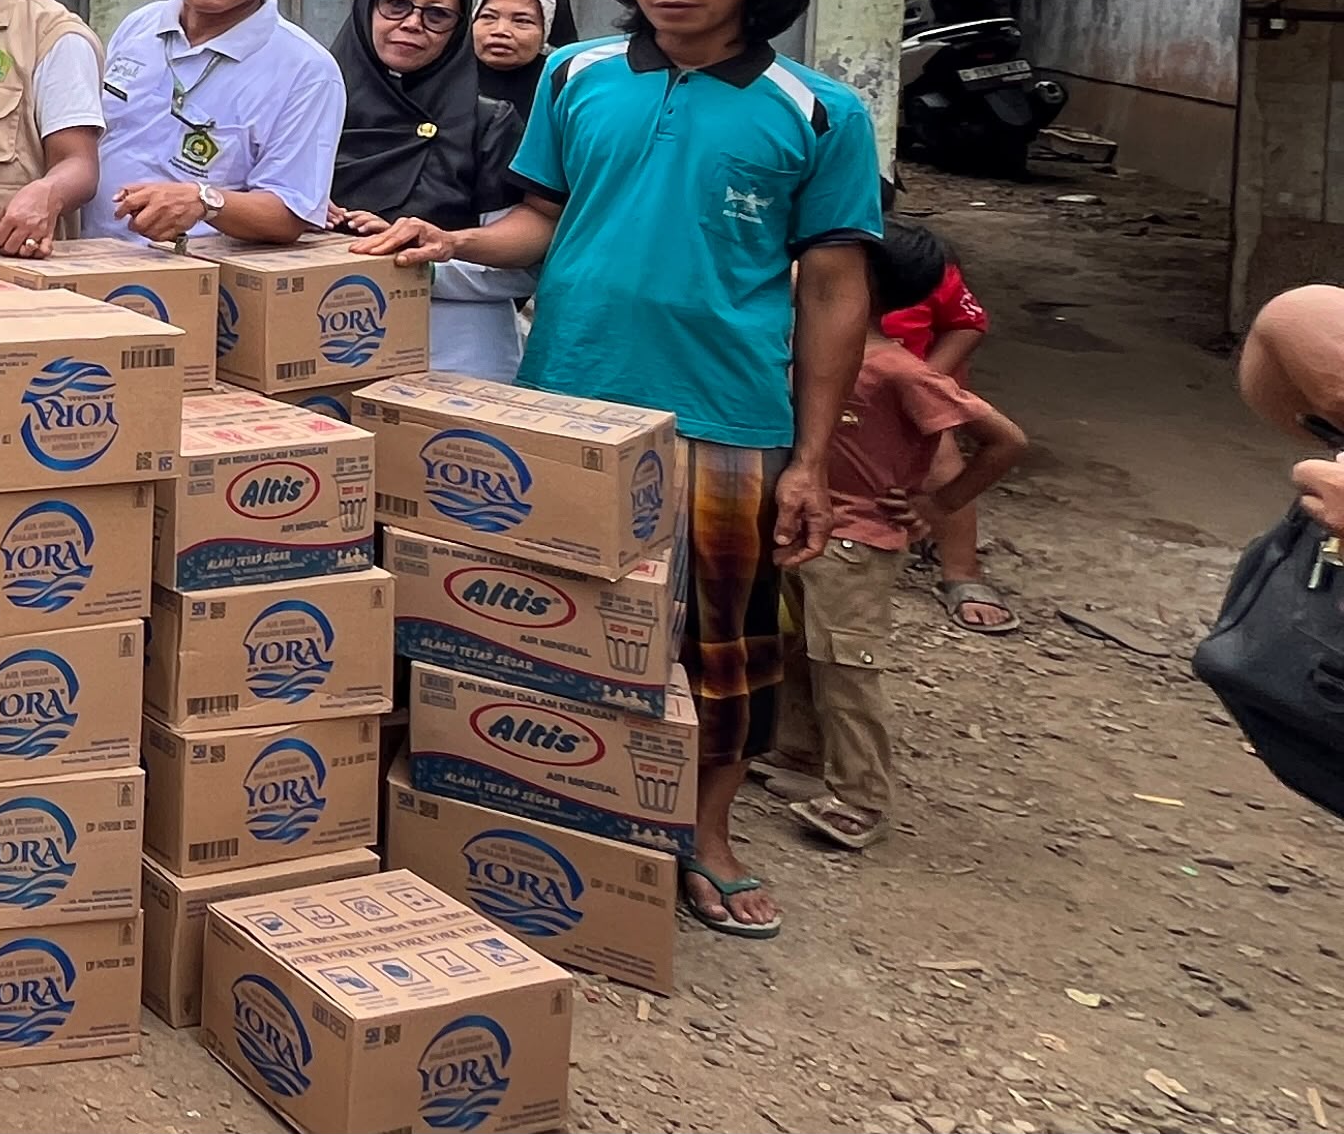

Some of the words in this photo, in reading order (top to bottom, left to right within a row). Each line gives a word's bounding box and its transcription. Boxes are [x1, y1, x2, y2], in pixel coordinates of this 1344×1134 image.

[318, 307, 378, 334] YORA
[33, 397, 116, 430] YORA
[240, 475, 305, 508] Altis
[424, 461, 514, 503] YORA
[1, 540, 82, 572] YORA
[431, 546, 450, 557] AIR
[451, 549, 488, 564] MINUM
[462, 578, 552, 617] Altis
[244, 636, 323, 667] YORA
[420, 637, 455, 655] ALAMI
[459, 646, 494, 664] TETAP
[496, 654, 534, 672] SEGAR
[520, 634, 538, 645] AIR
[539, 638, 591, 658] MINERAL
[457, 680, 474, 691] AIR
[476, 683, 515, 701] MINUM
[517, 691, 558, 709] DALAM
[488, 714, 580, 754] Altis
[243, 775, 317, 806] YORA
[444, 771, 481, 790] ALAMI
[482, 780, 520, 799] TETAP
[521, 789, 561, 810] SEGAR
[546, 771, 566, 783] AIR
[566, 776, 620, 796] MINERAL
[465, 855, 562, 904] YORA
[234, 997, 301, 1072] YORA
[417, 1053, 503, 1093] YORA
